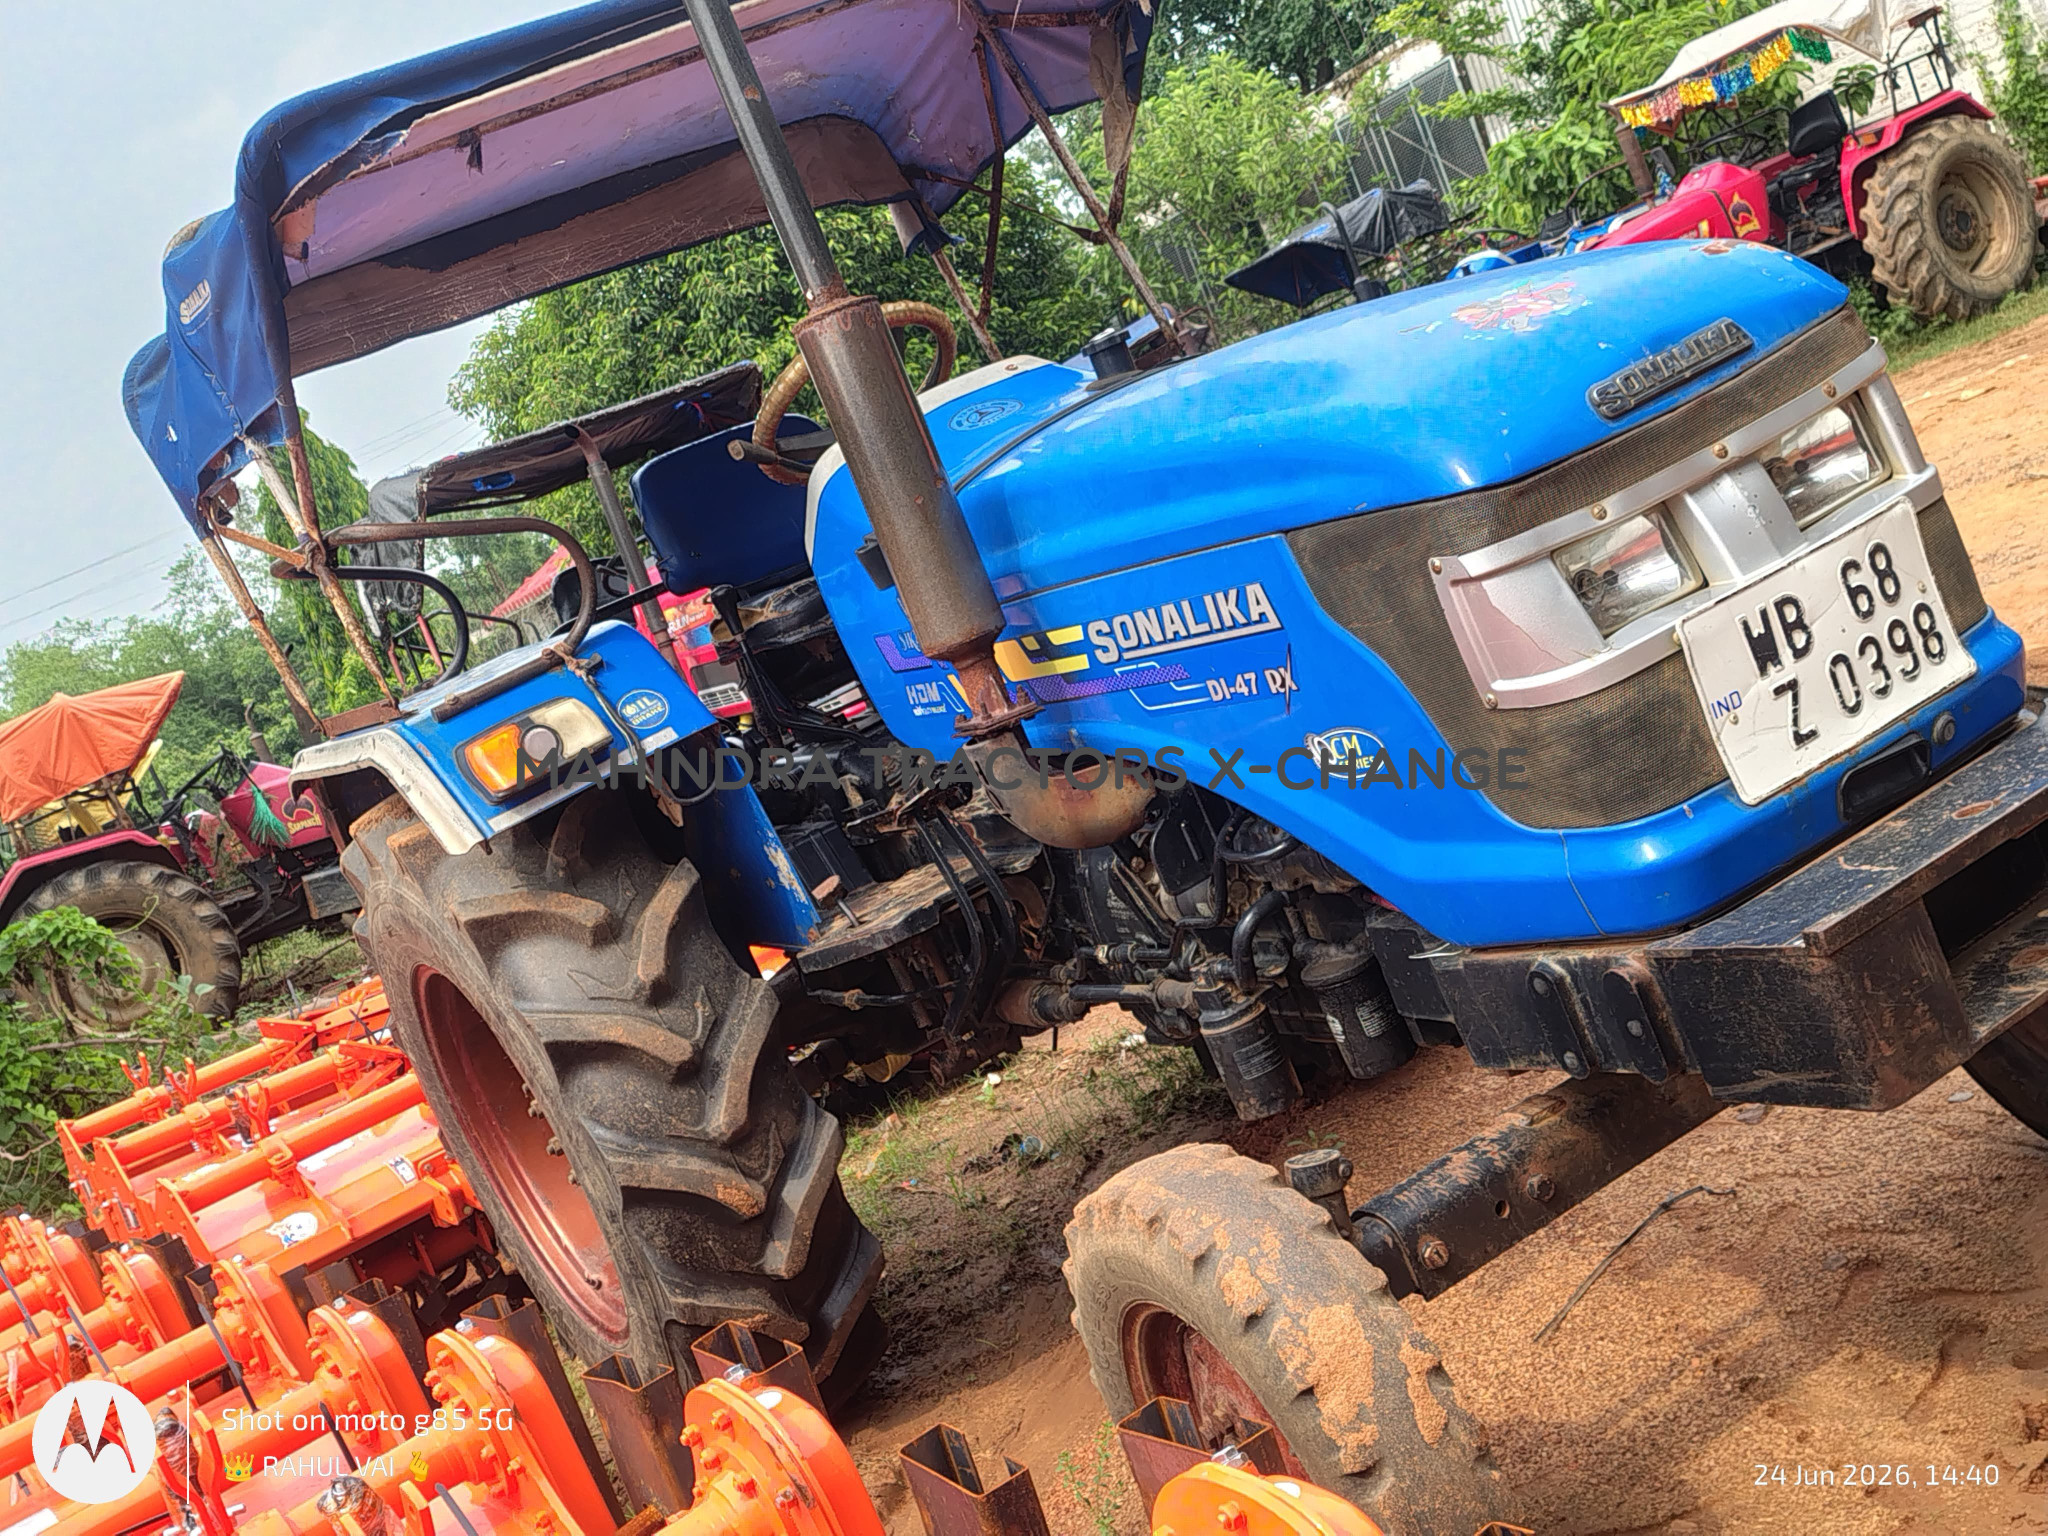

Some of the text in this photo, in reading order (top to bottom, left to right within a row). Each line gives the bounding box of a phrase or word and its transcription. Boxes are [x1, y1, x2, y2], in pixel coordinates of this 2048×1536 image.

[1592, 319, 1749, 419] SONALIKA
[1087, 582, 1283, 665] SONALIKA
[1739, 540, 1901, 678] WB 68
[621, 695, 659, 718] OIL
[1205, 671, 1258, 702] DI-47
[1711, 690, 1744, 720] IND
[1769, 601, 1948, 750] Z 0398
